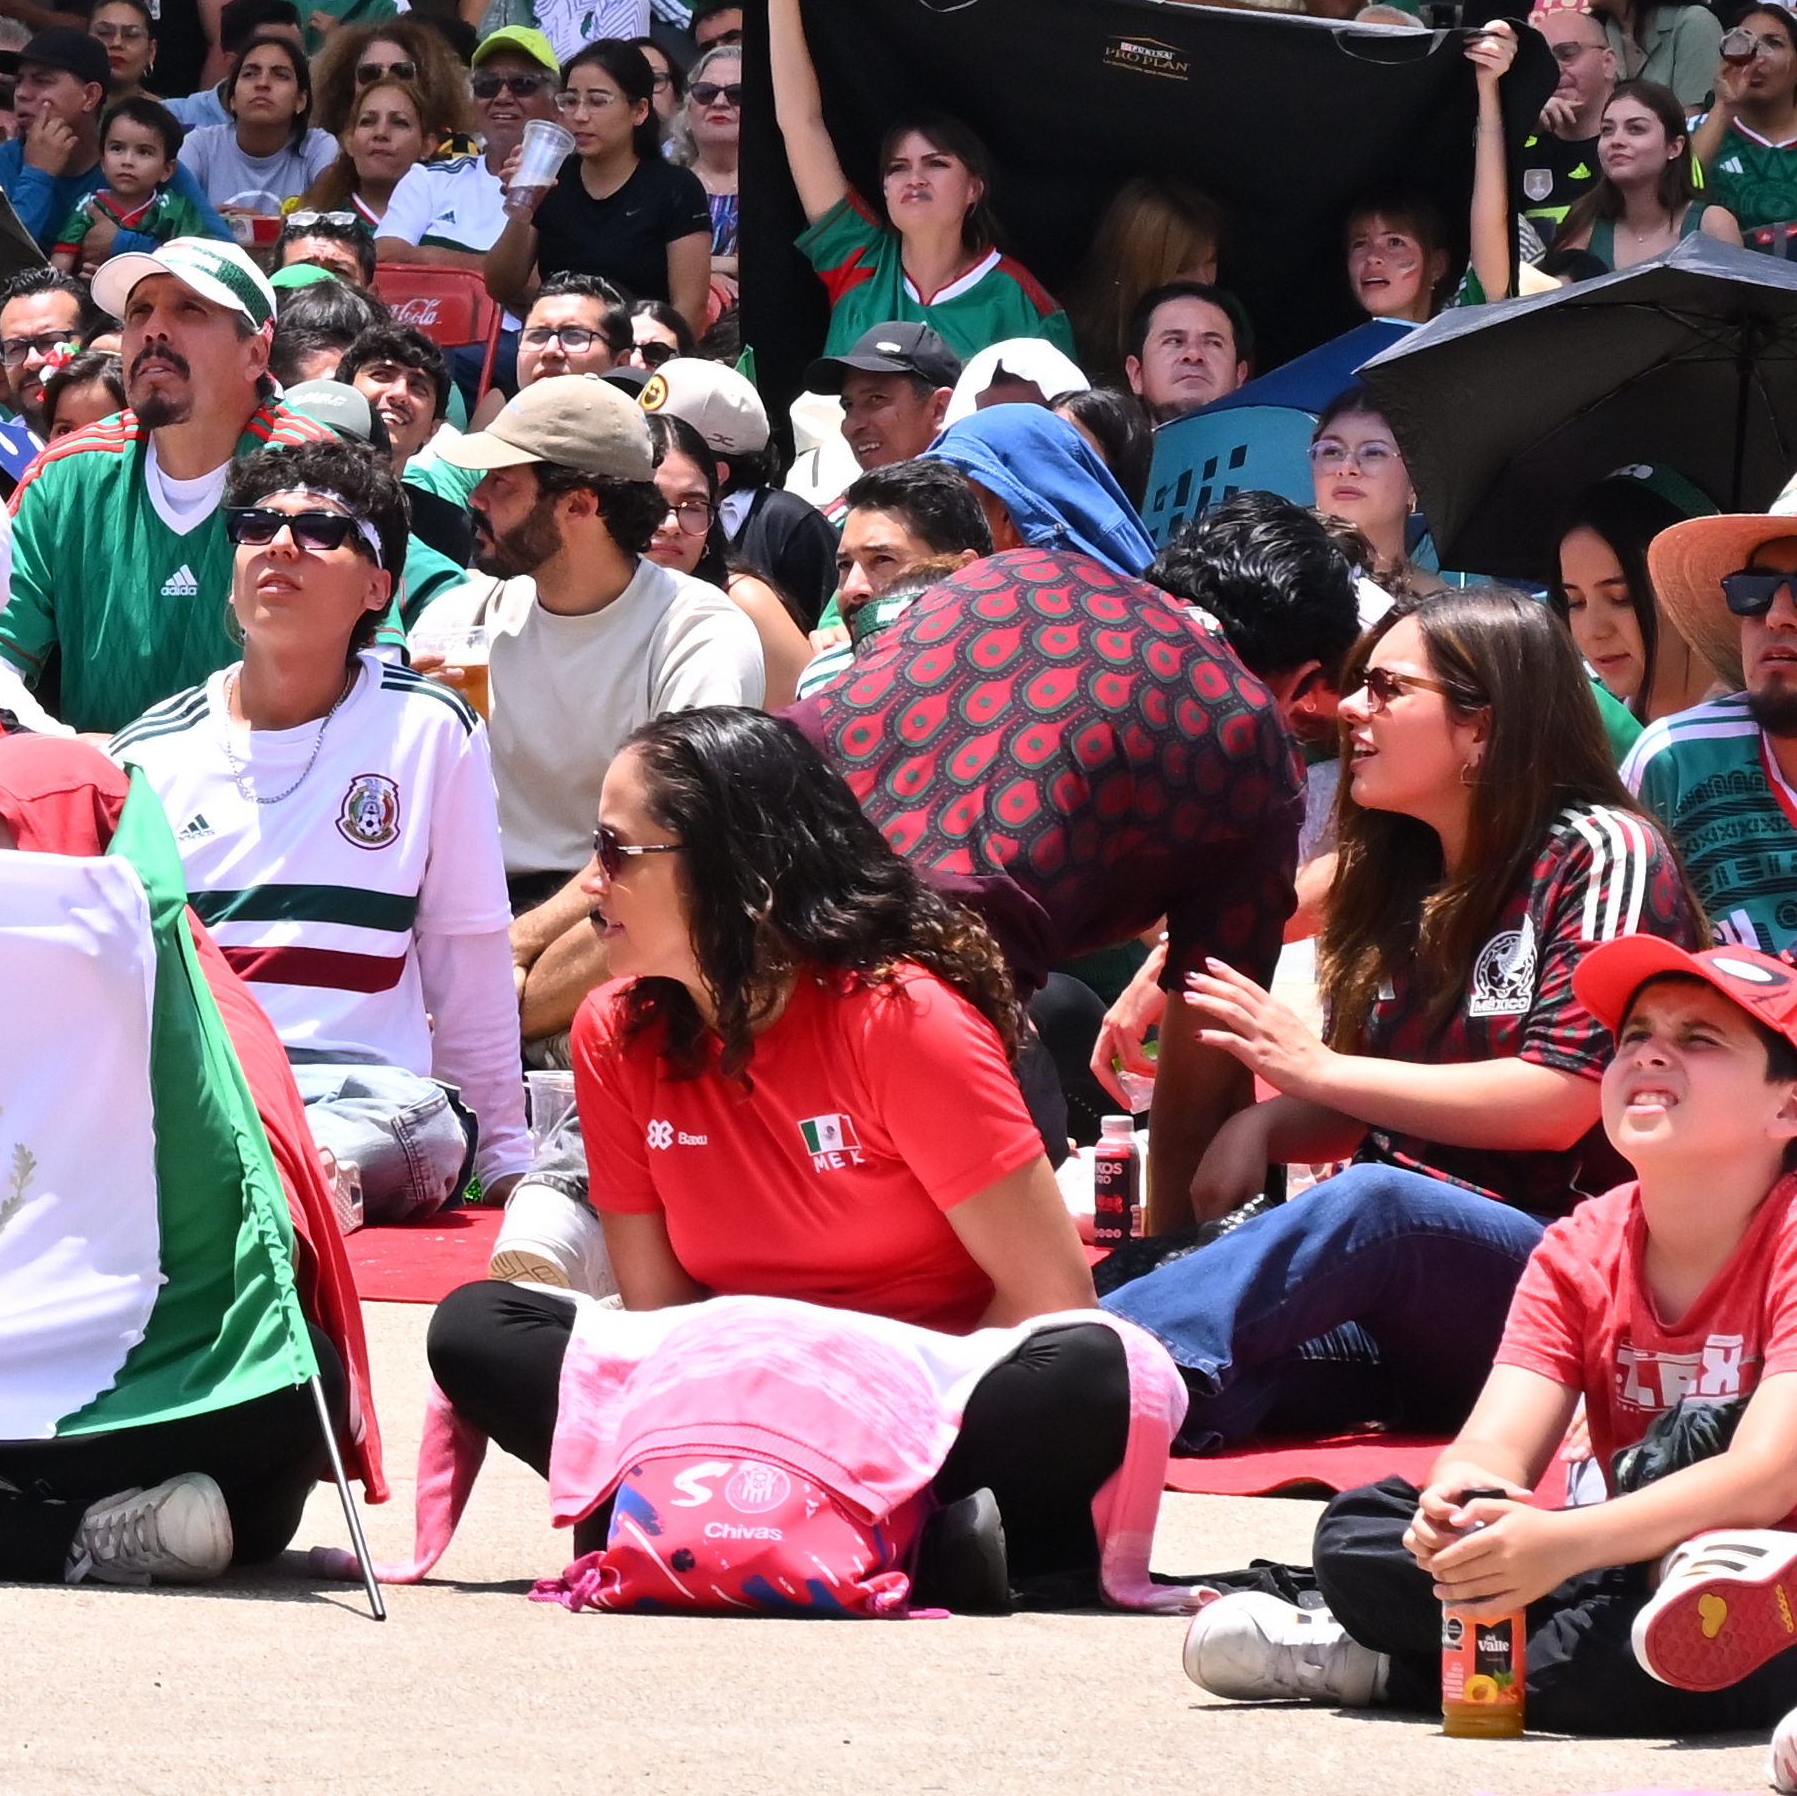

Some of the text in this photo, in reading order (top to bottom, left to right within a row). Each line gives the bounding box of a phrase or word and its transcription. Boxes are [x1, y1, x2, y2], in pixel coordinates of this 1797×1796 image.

[1105, 47, 1140, 62] PRO
[1142, 53, 1189, 73] PLAN
[703, 1521, 783, 1542] Chivas
[1478, 1638, 1510, 1654] Valle
